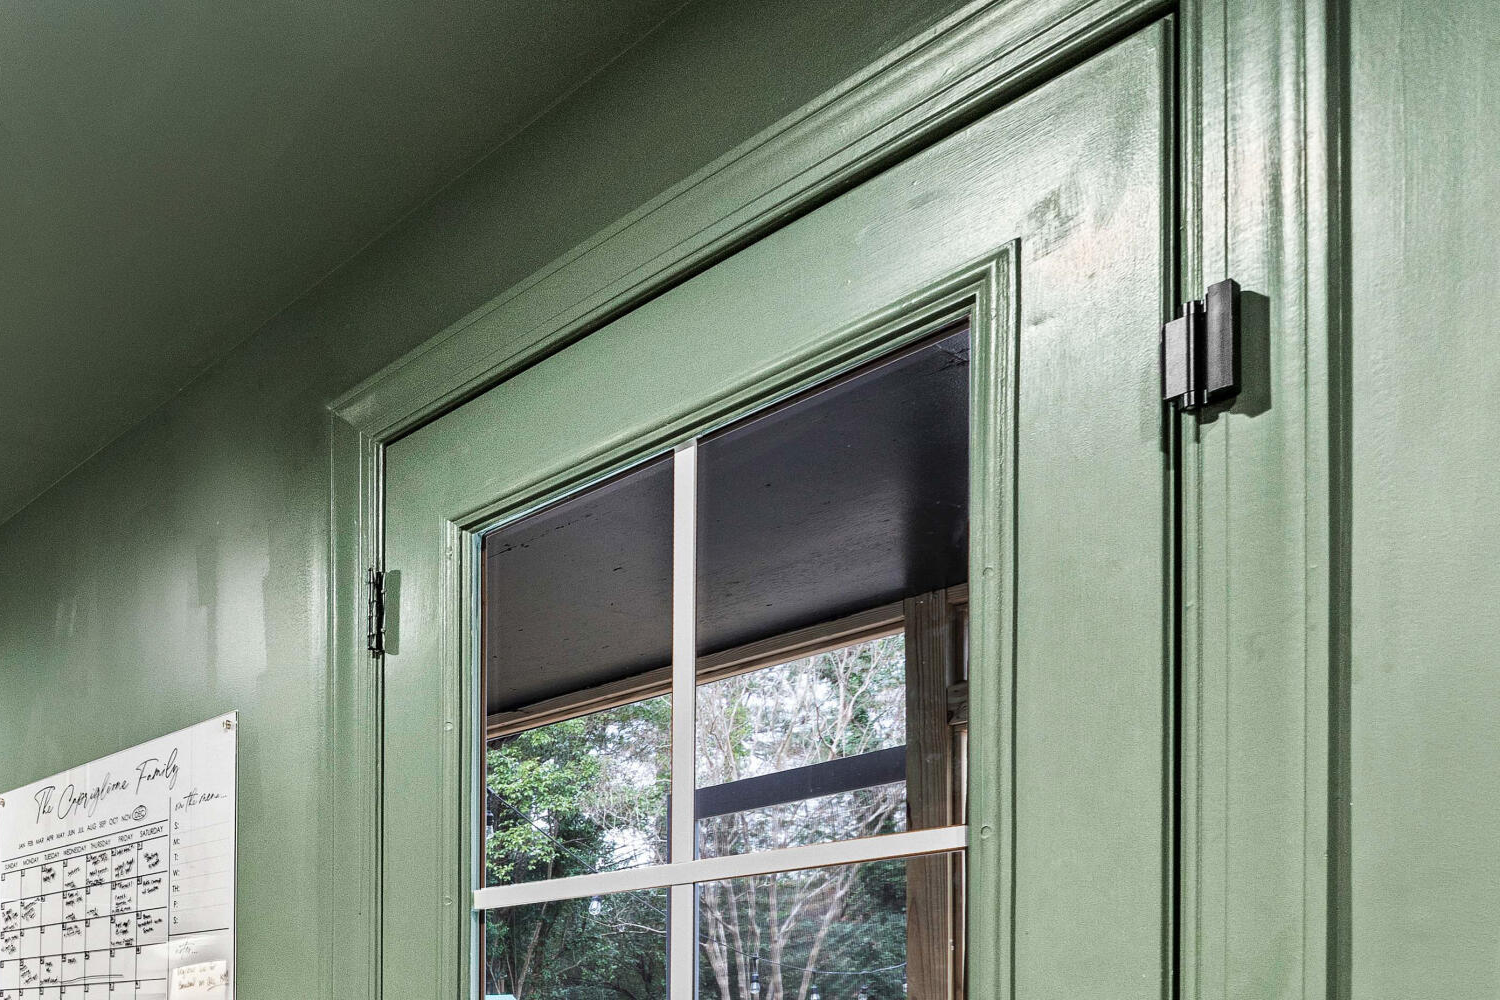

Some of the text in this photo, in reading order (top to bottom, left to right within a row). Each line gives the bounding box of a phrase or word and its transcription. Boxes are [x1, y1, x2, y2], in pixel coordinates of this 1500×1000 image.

[33, 785, 56, 824] The
[135, 747, 180, 795] Family
[4, 826, 164, 870] SUNDAY MONDAY TUESDAY WEDNESDAY THURSDAY FRIDAY SATURDAY
[18, 842, 26, 850] JAN
[86, 823, 97, 831] AUG
[99, 820, 107, 828] SEP
[109, 817, 118, 826] OCT
[134, 810, 146, 818] DEC
